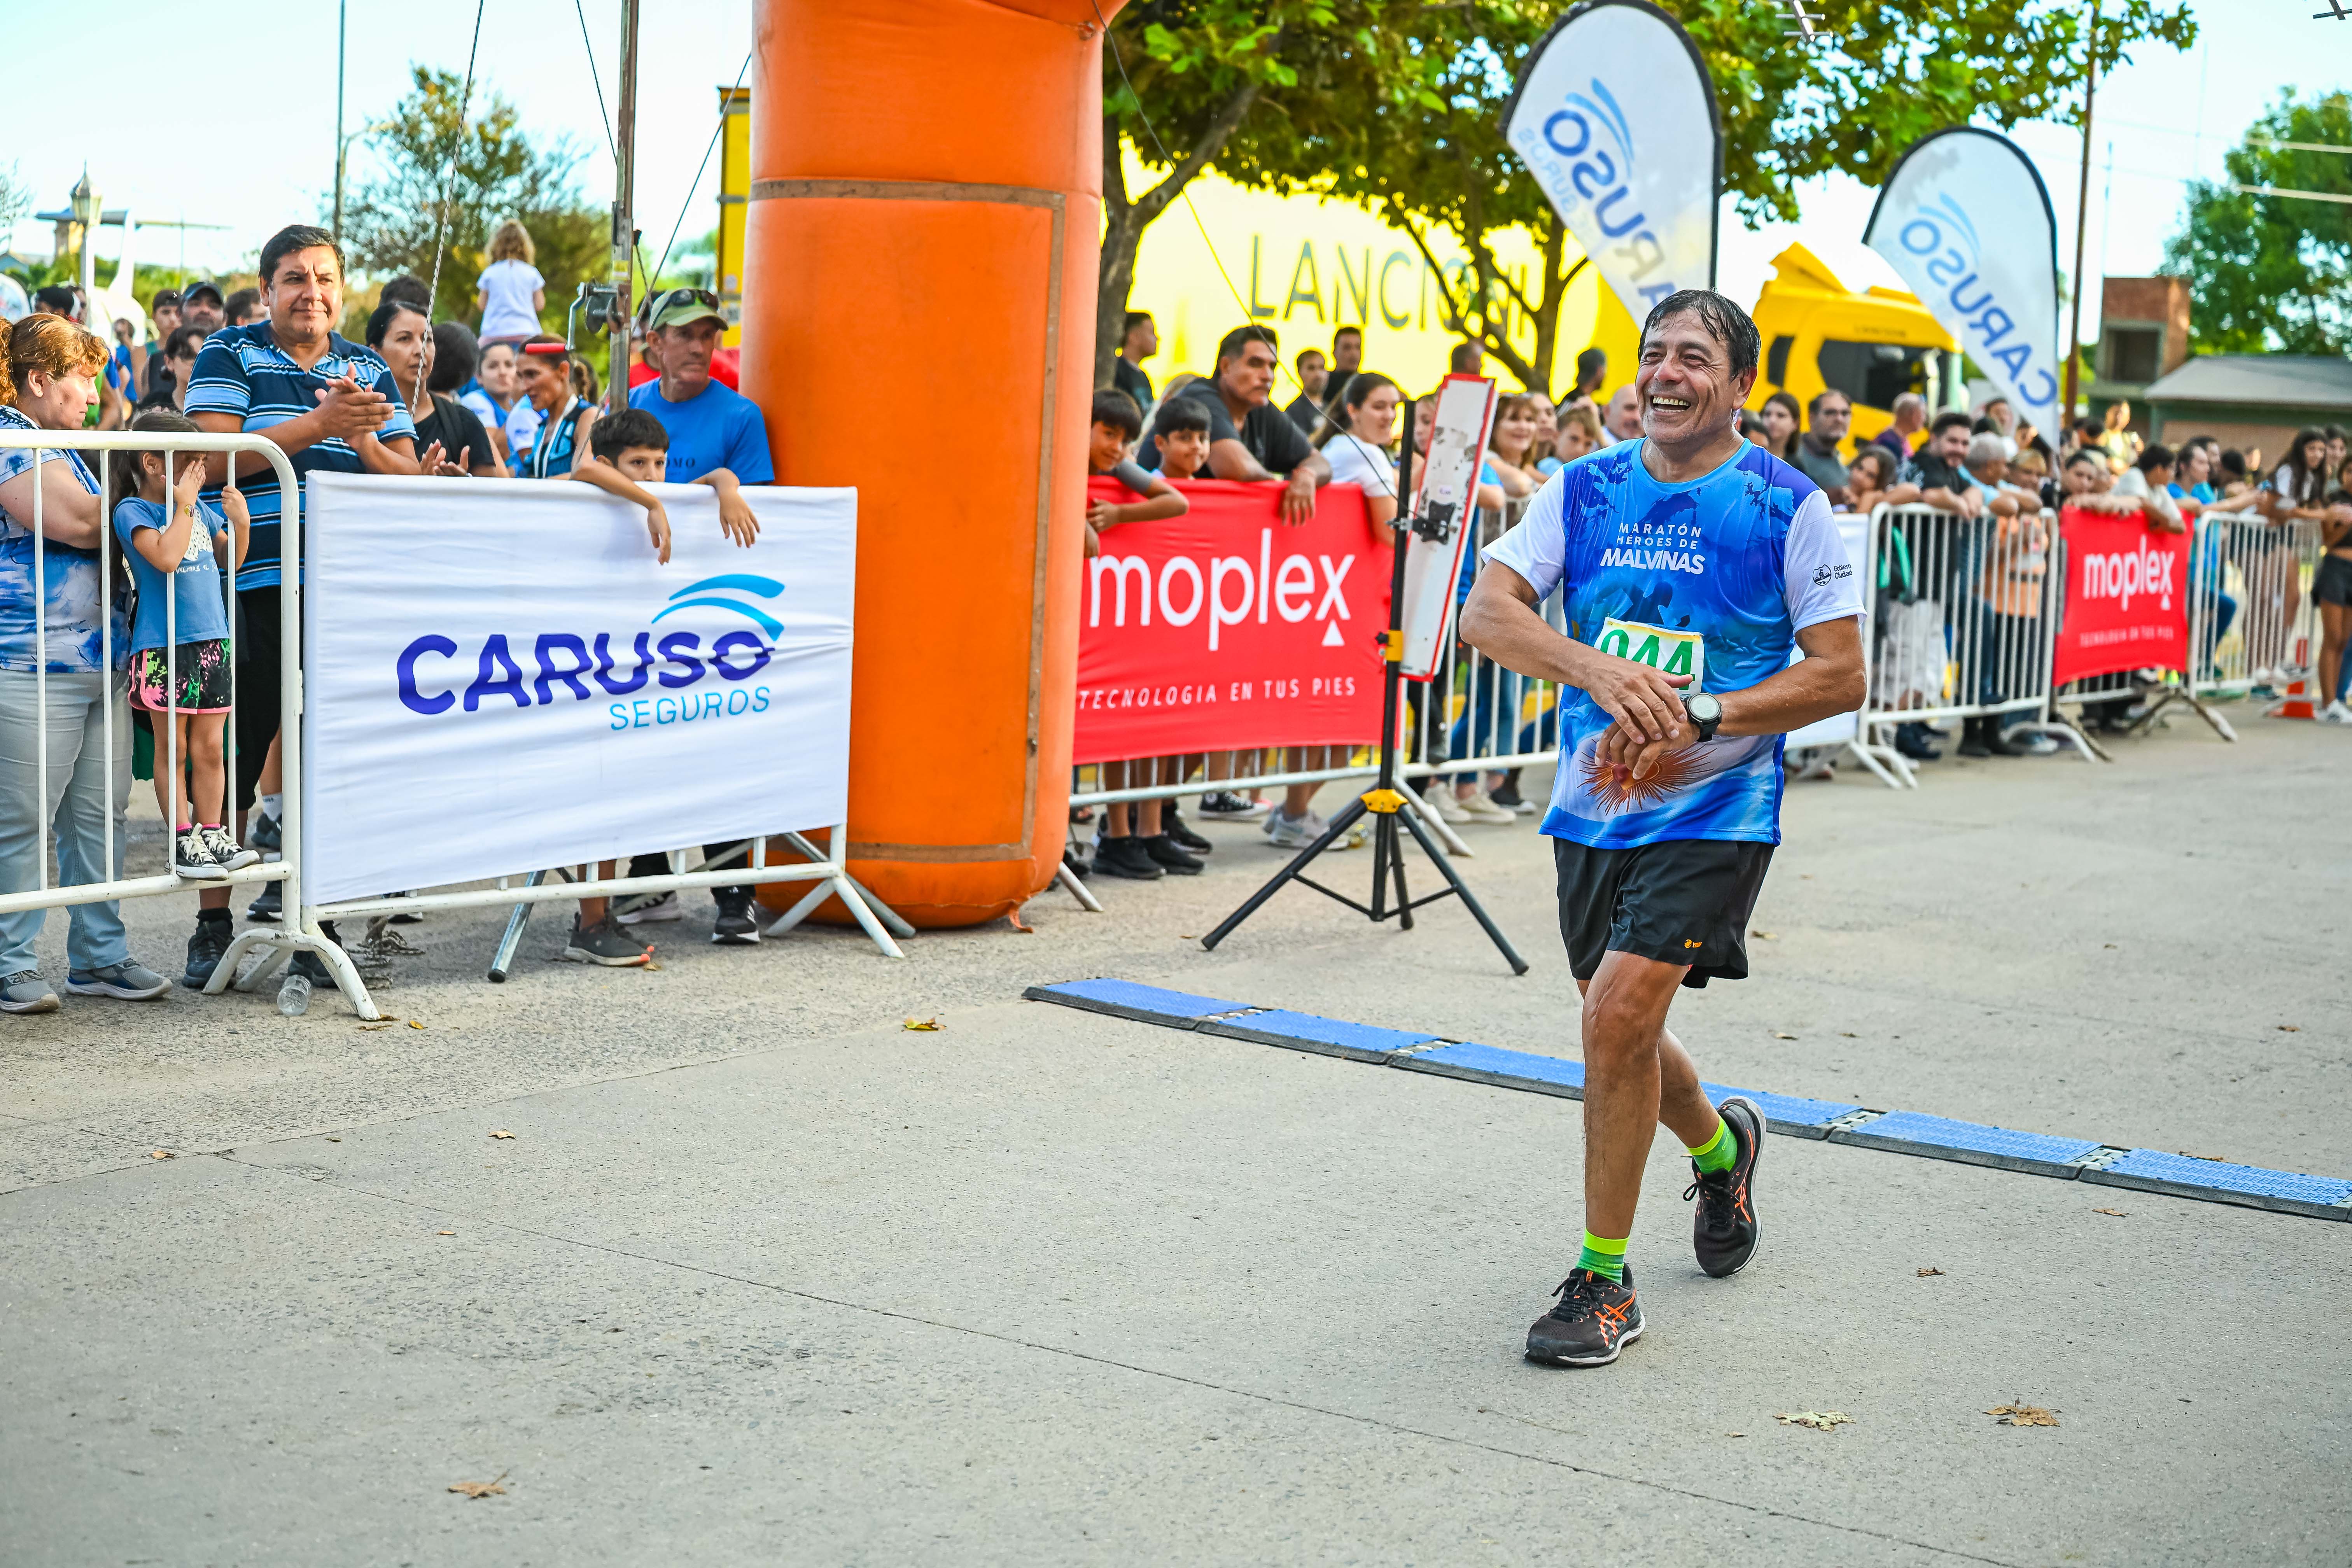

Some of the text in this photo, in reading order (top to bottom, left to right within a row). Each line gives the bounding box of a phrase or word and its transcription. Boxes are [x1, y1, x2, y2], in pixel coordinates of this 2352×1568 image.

[1616, 535, 1698, 550] HÉROES DE
[1619, 522, 1702, 537] MARATÓN
[1600, 548, 1706, 575] MALVINAS
[1834, 570, 1853, 579] Ciudad
[2083, 534, 2175, 611] moplex
[1089, 528, 1356, 651] moplex
[396, 630, 776, 716] CARUSO
[1600, 629, 1696, 691] 044
[609, 686, 772, 731] SEGUROS
[1079, 677, 1356, 710] TECNOLOGIA EN TUS PIES
